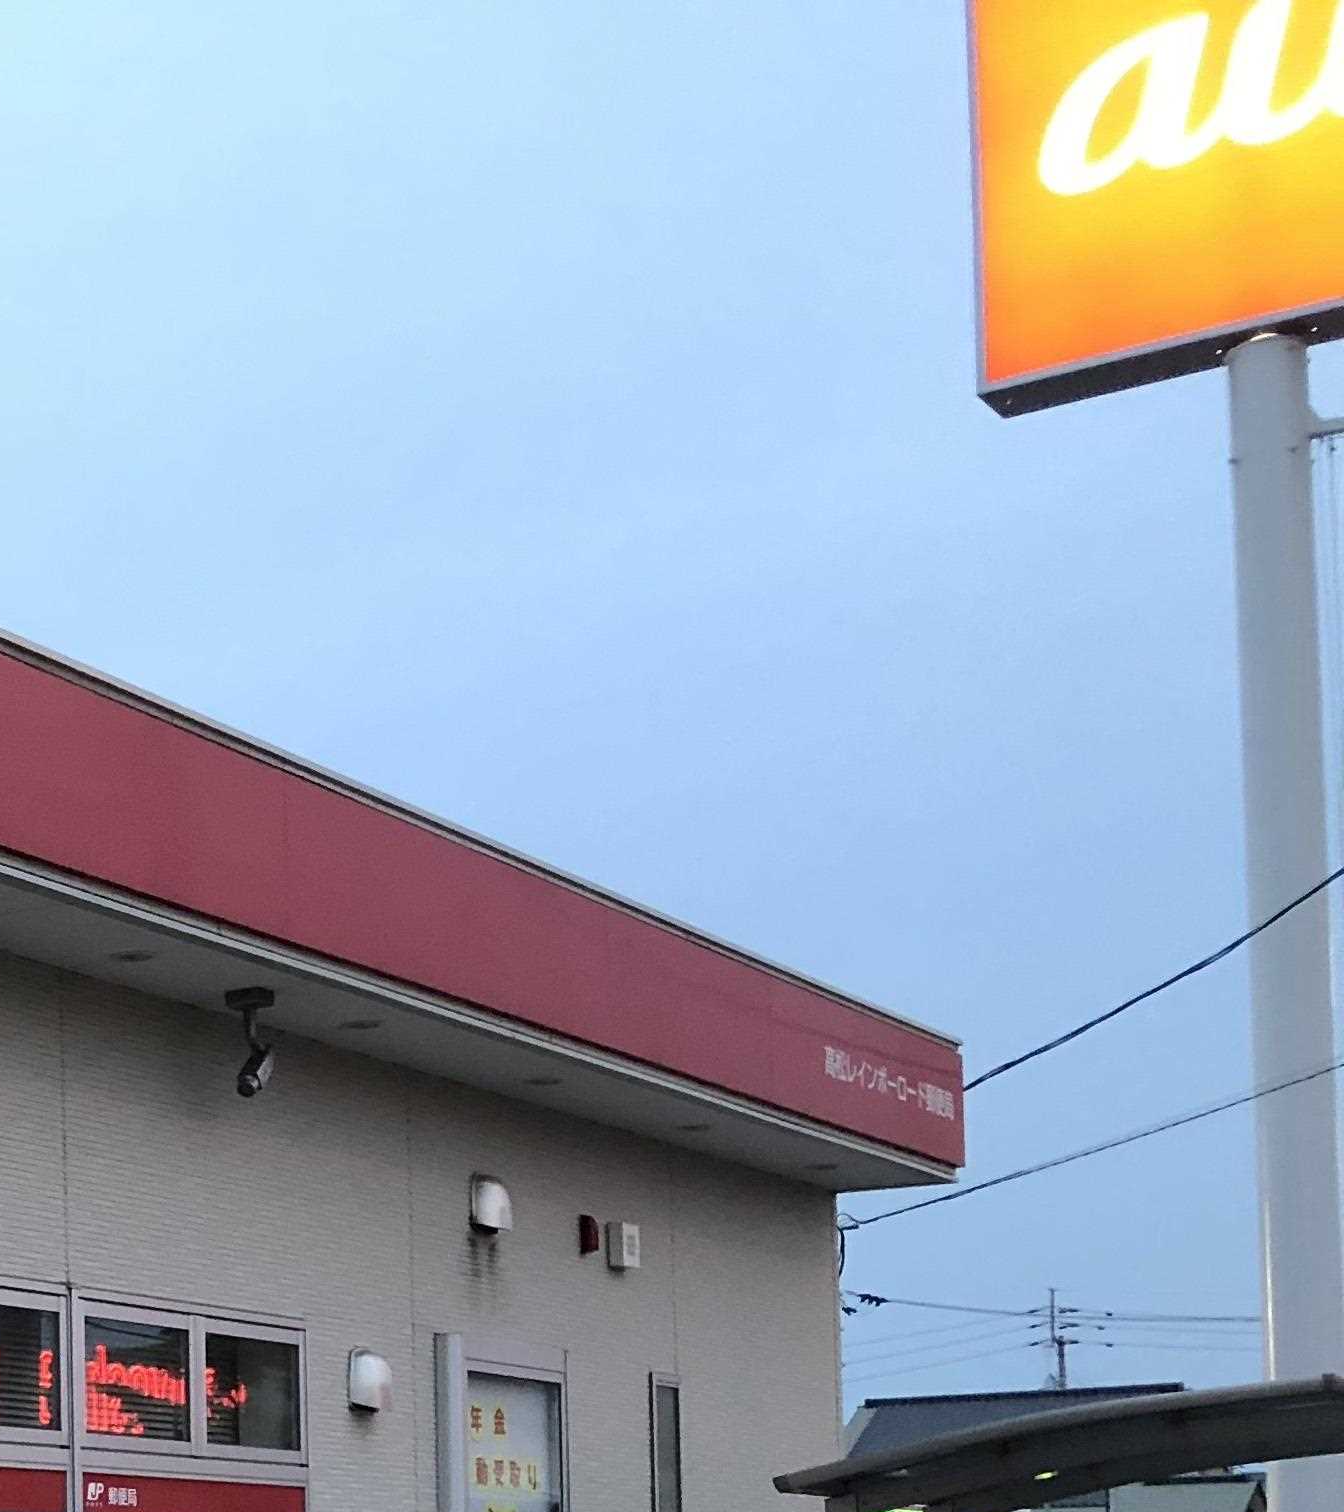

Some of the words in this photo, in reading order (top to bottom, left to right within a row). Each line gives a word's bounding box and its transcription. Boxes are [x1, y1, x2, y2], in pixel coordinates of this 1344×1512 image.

[1037, 0, 1344, 196] au
[108, 1486, 138, 1507] 郵便局
